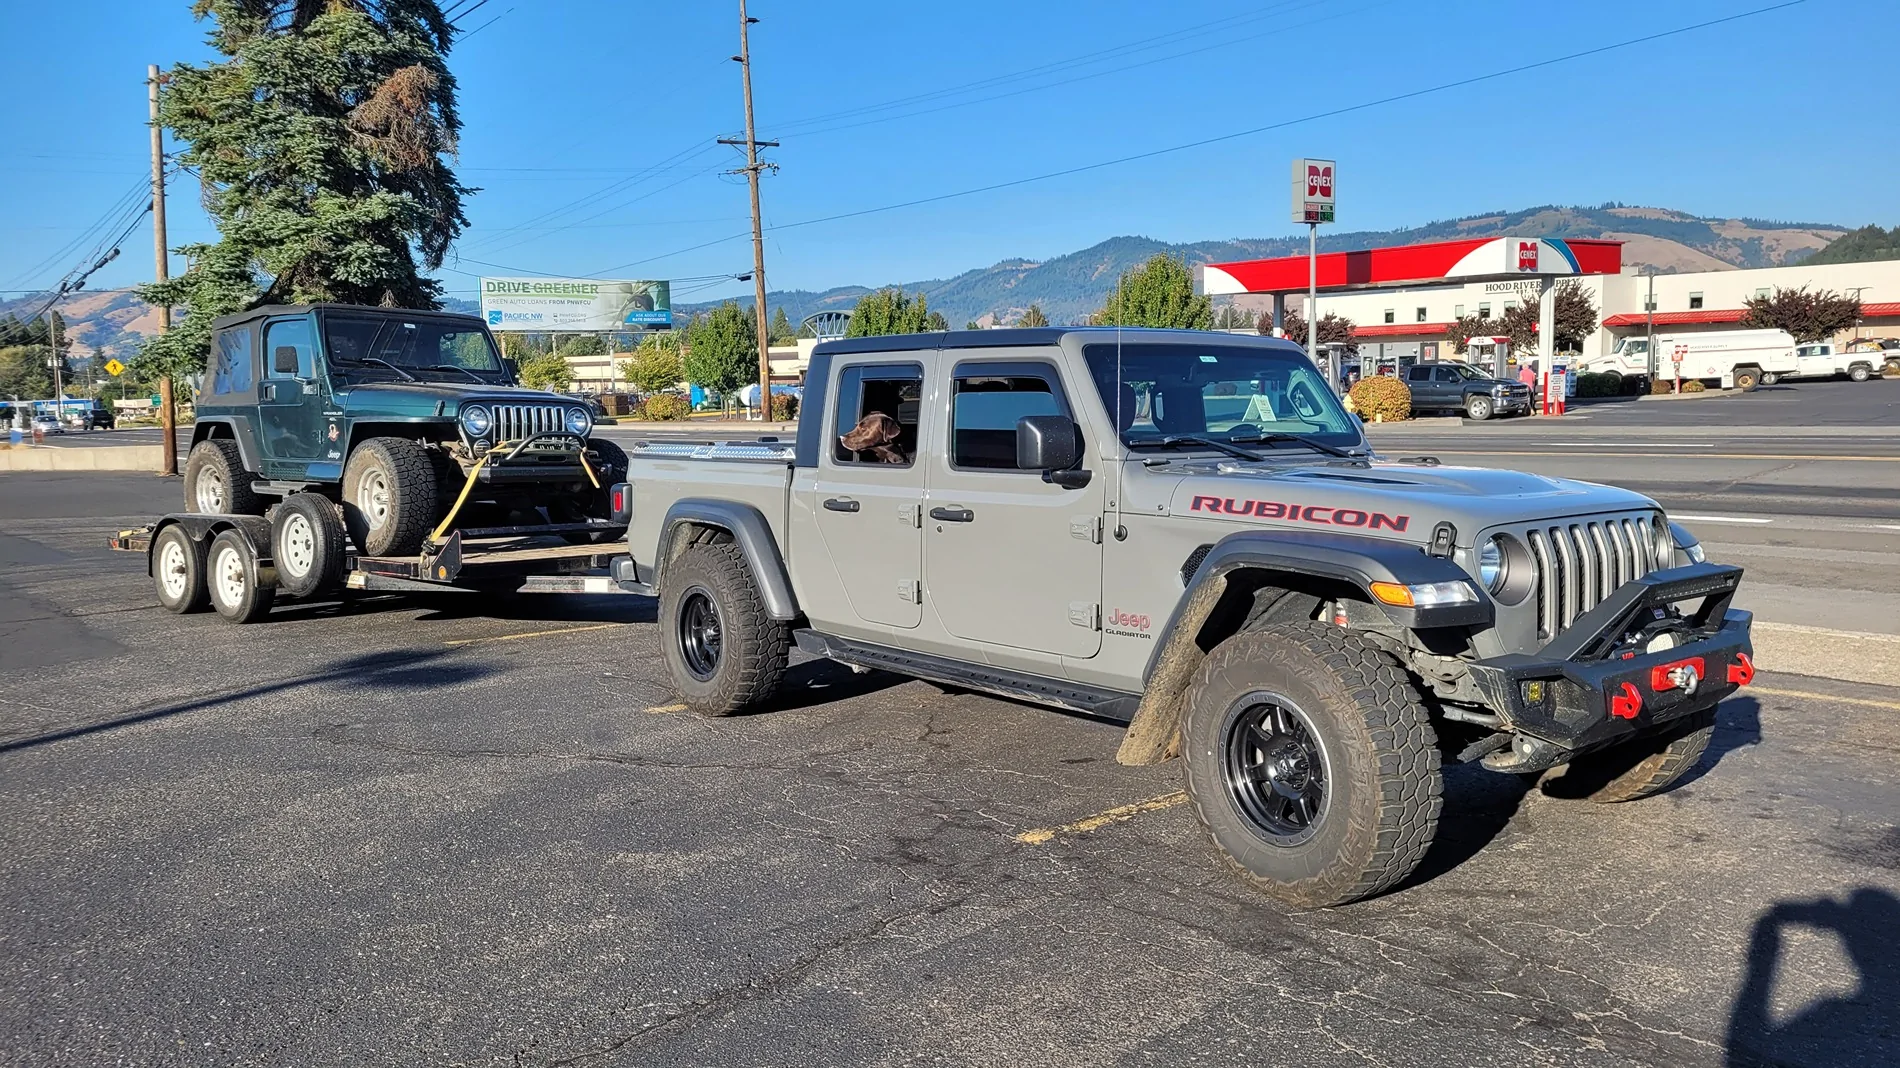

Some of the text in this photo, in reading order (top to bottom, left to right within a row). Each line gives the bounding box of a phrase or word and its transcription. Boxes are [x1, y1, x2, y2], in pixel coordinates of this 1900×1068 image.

[1308, 175, 1331, 187] CENEX
[1520, 250, 1536, 260] CENEX
[486, 282, 598, 294] DRIVE GREENER
[1485, 278, 1579, 292] HOOD RIVER PPLY
[328, 450, 341, 460] Jeep
[1190, 495, 1410, 532] RUBICON
[1108, 608, 1151, 632] Jeep
[1105, 628, 1152, 640] GLADIATOR
